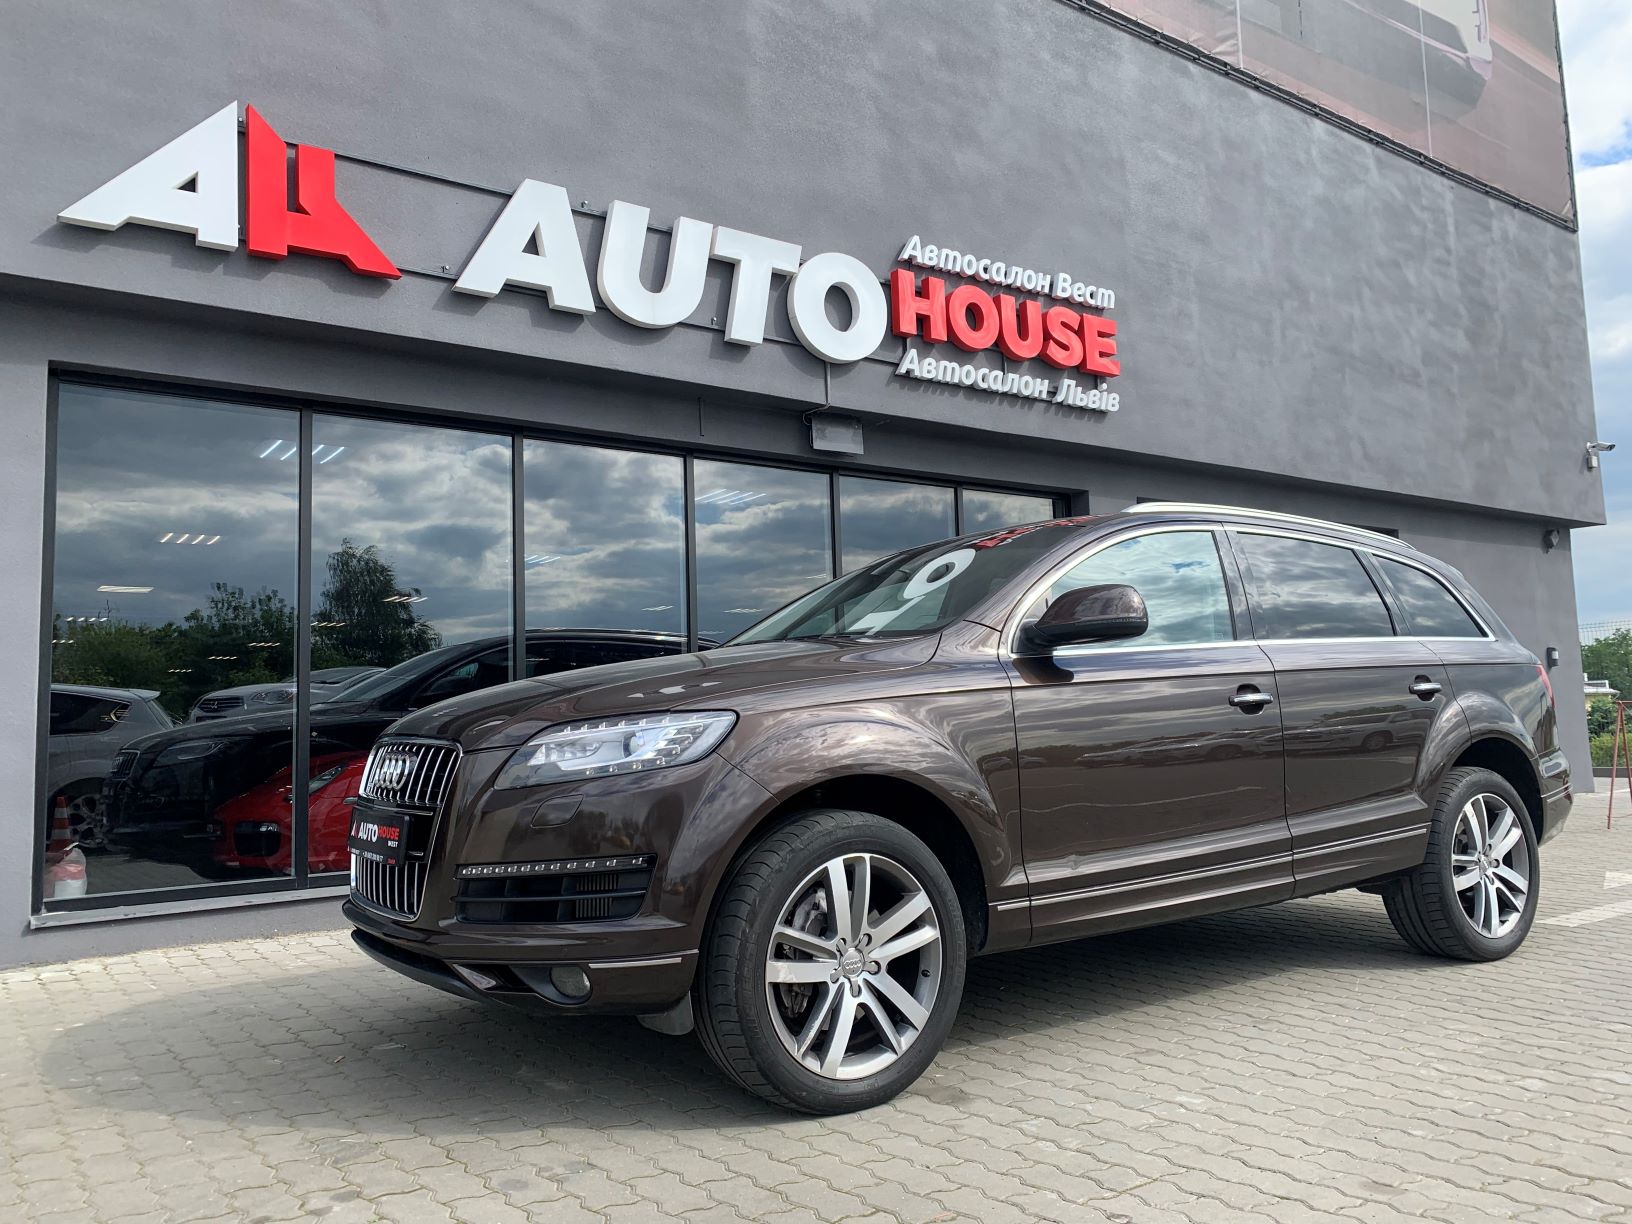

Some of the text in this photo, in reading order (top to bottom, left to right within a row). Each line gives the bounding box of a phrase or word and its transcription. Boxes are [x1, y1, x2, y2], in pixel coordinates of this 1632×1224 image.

[453, 178, 1120, 378] AUTO HOUSE
[898, 234, 1116, 310] Автосалон Вест
[895, 348, 1121, 413] Автосалон Львів
